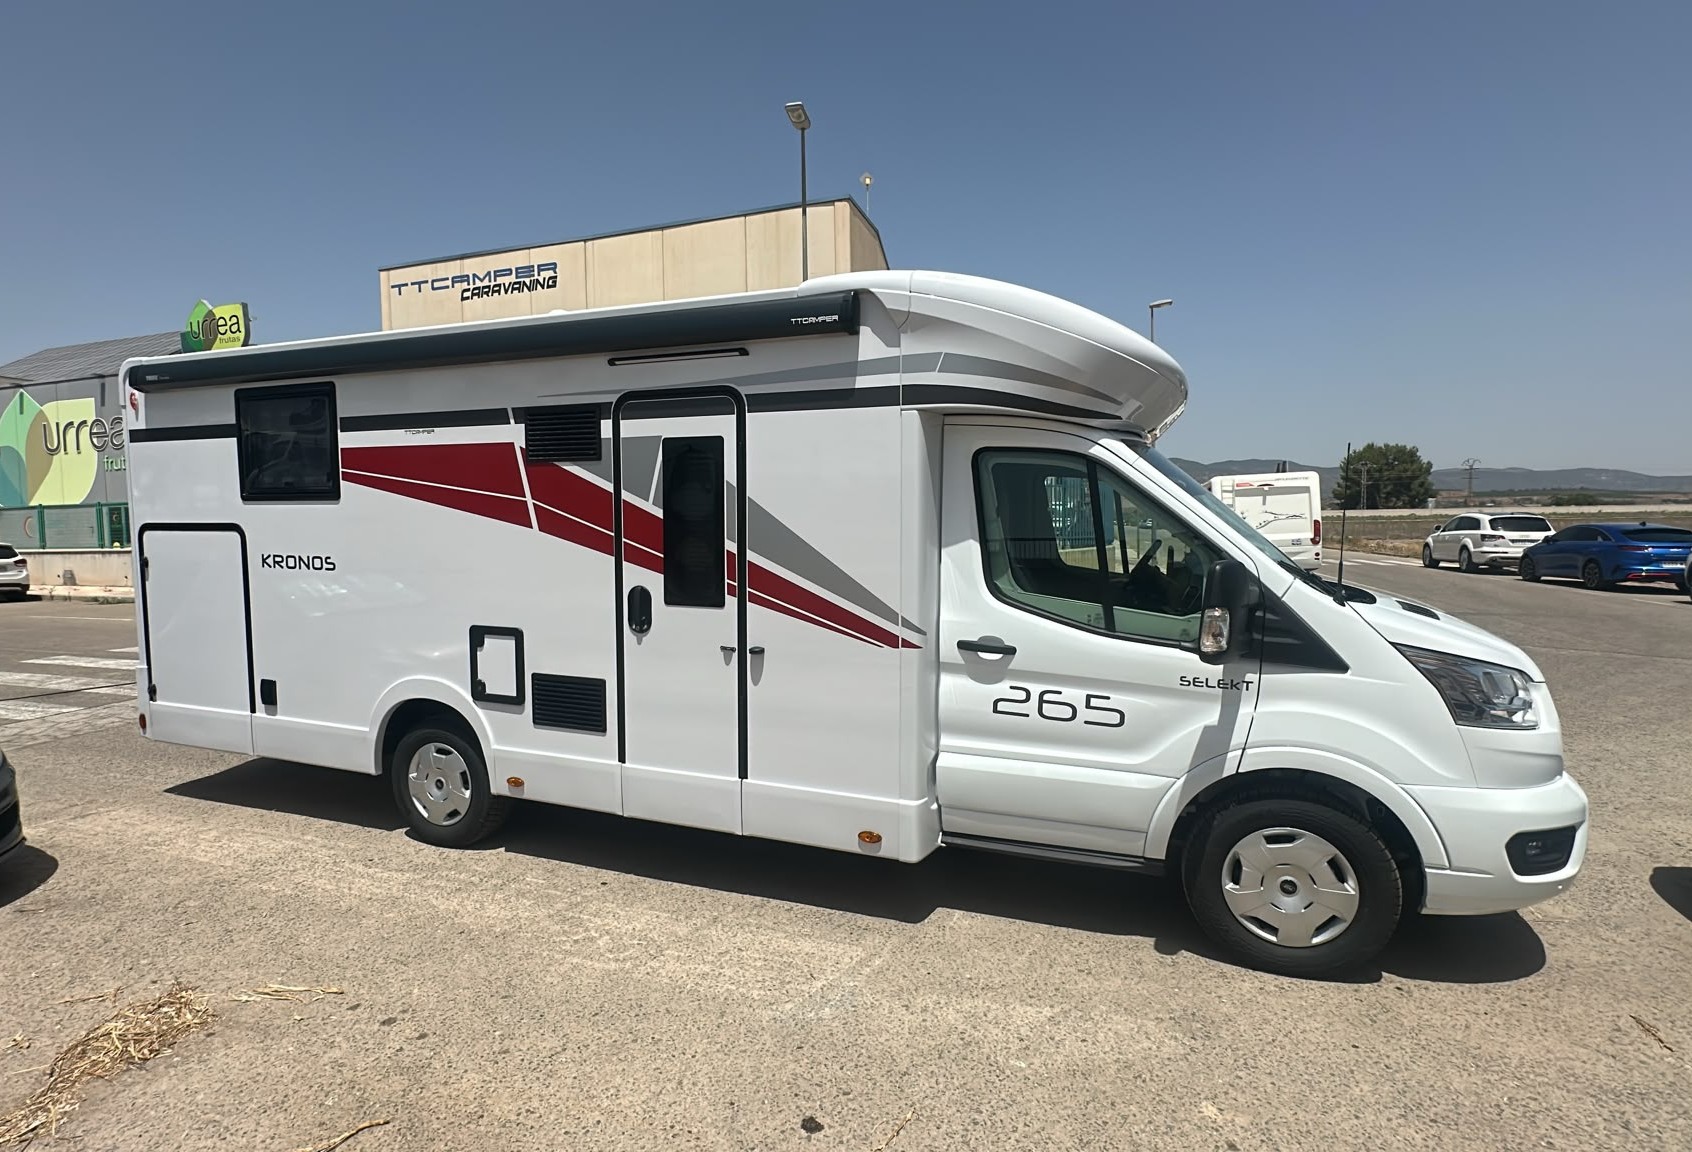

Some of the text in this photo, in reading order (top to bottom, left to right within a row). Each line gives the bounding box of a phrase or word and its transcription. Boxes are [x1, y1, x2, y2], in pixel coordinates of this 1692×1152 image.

[390, 261, 558, 296] TTCAMPER
[460, 275, 558, 302] CARAVANING
[189, 314, 241, 340] urrea
[790, 314, 839, 325] TTCAMPER
[218, 335, 241, 344] frutas
[42, 415, 125, 456] urrea
[104, 454, 127, 472] frut
[261, 553, 337, 571] KRONOS
[1178, 675, 1254, 692] SELEKT
[992, 685, 1126, 728] 265
